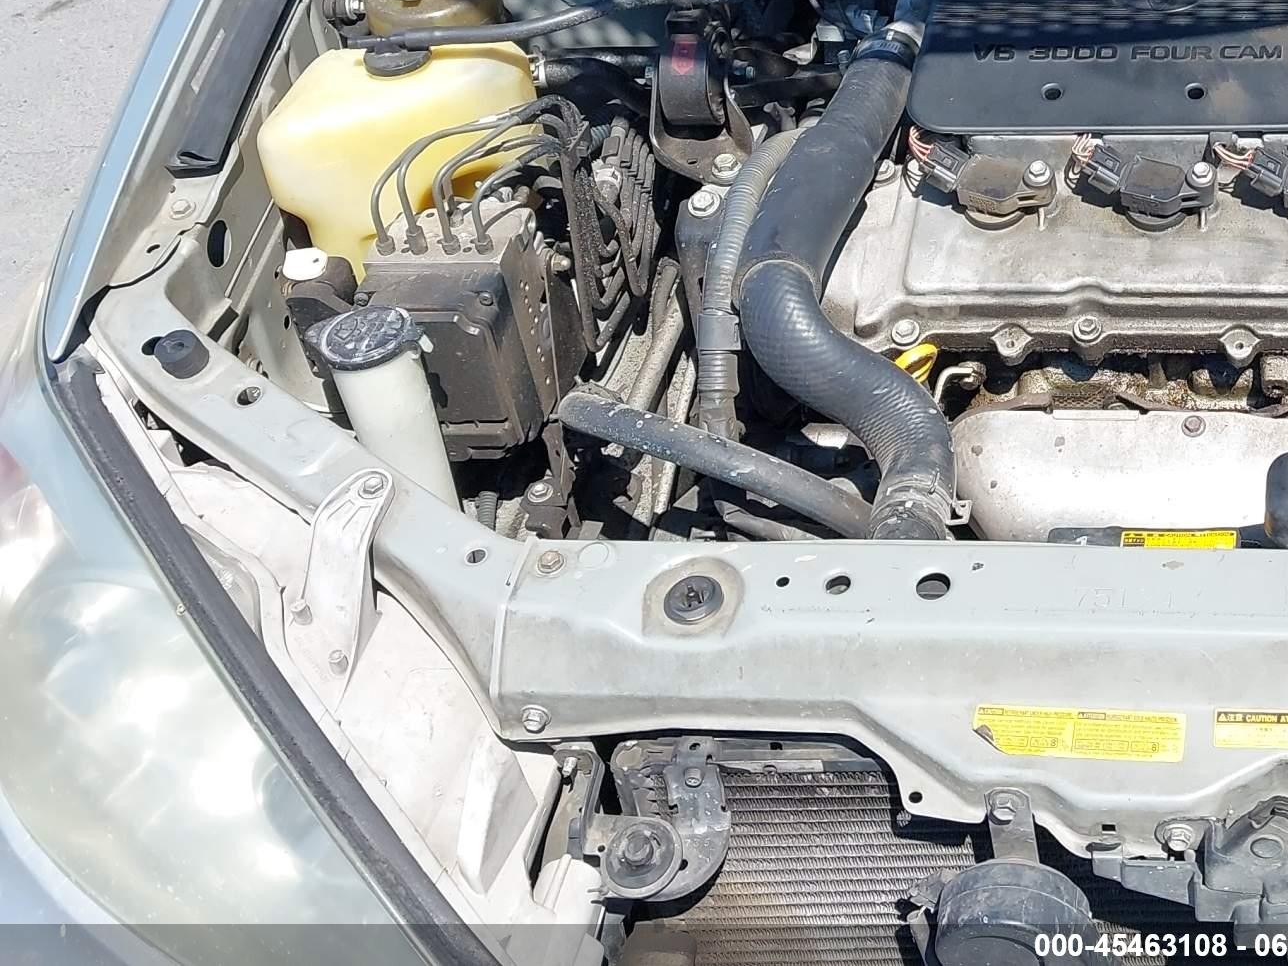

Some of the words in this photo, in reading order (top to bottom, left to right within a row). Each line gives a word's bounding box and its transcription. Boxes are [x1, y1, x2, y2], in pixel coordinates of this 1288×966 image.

[973, 43, 1015, 61] V6
[1028, 43, 1118, 61] 3000
[1130, 43, 1212, 61] FOUR
[1219, 43, 1282, 60] CAM
[1245, 713, 1278, 723] CAUTION
